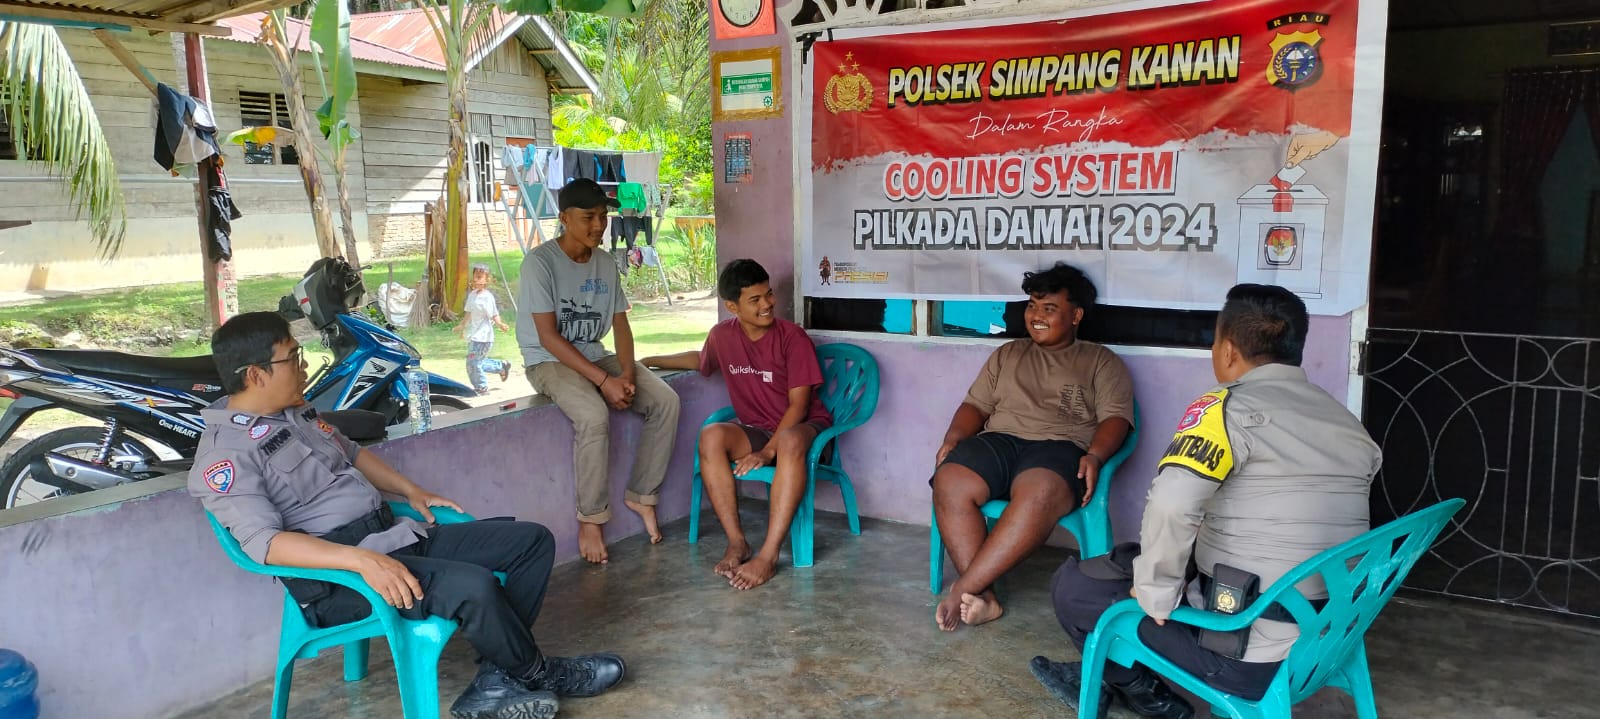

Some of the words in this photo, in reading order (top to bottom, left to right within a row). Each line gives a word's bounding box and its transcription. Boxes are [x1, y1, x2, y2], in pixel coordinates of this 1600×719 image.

[1273, 14, 1324, 27] RIAU
[887, 61, 985, 105] POLSEK
[989, 48, 1121, 98] SIMPANG
[1128, 35, 1241, 88] KANAN
[966, 112, 1035, 139] Dalam
[1037, 106, 1123, 141] Rangka
[884, 157, 1025, 200] COOLING
[1031, 151, 1178, 196] SYSTEM
[854, 208, 980, 248] PILKADA
[986, 205, 1103, 249] DAMAI
[1109, 202, 1217, 249] 2024
[158, 418, 173, 430] One
